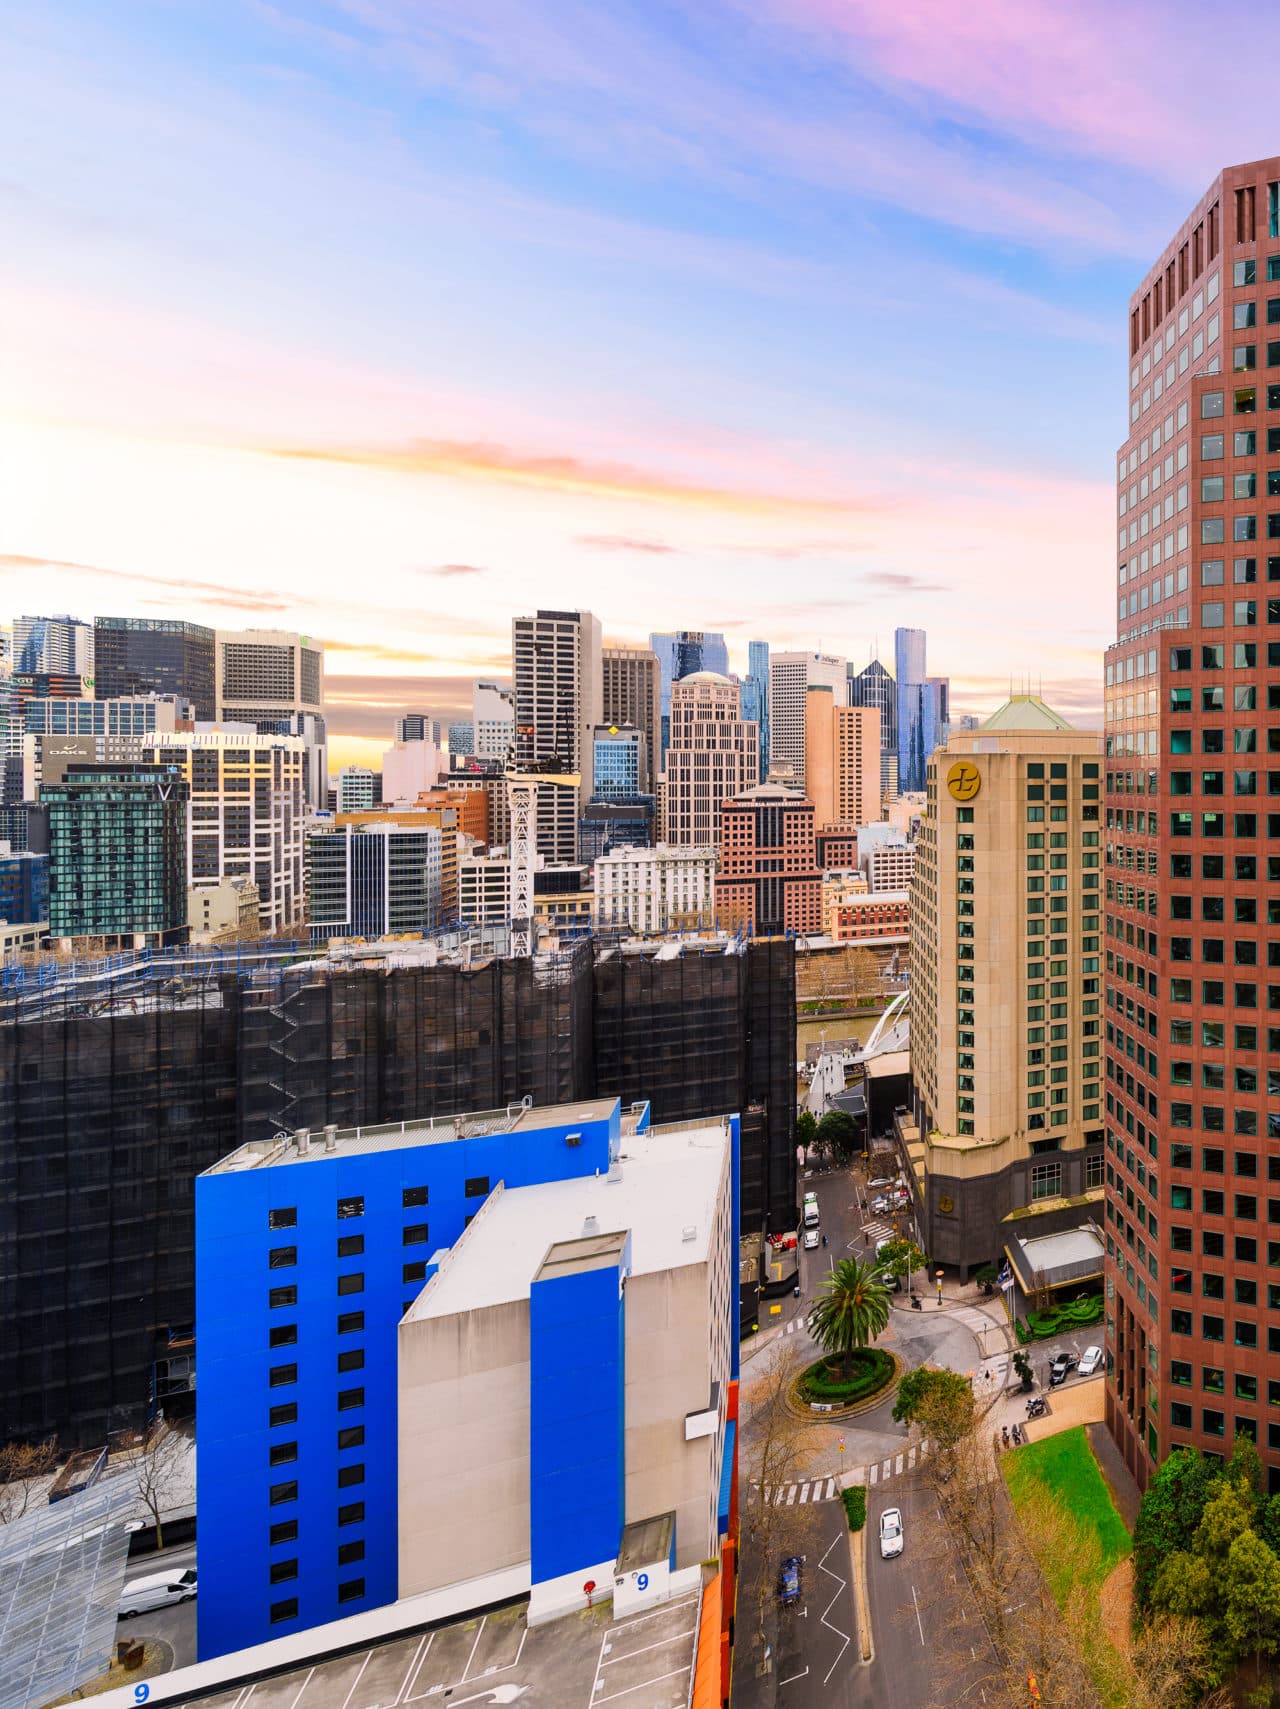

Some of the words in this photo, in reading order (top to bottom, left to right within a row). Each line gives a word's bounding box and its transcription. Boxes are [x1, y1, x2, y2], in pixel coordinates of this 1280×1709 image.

[157, 784, 172, 801] V
[637, 1573, 649, 1591] 9
[134, 1683, 150, 1704] 9
